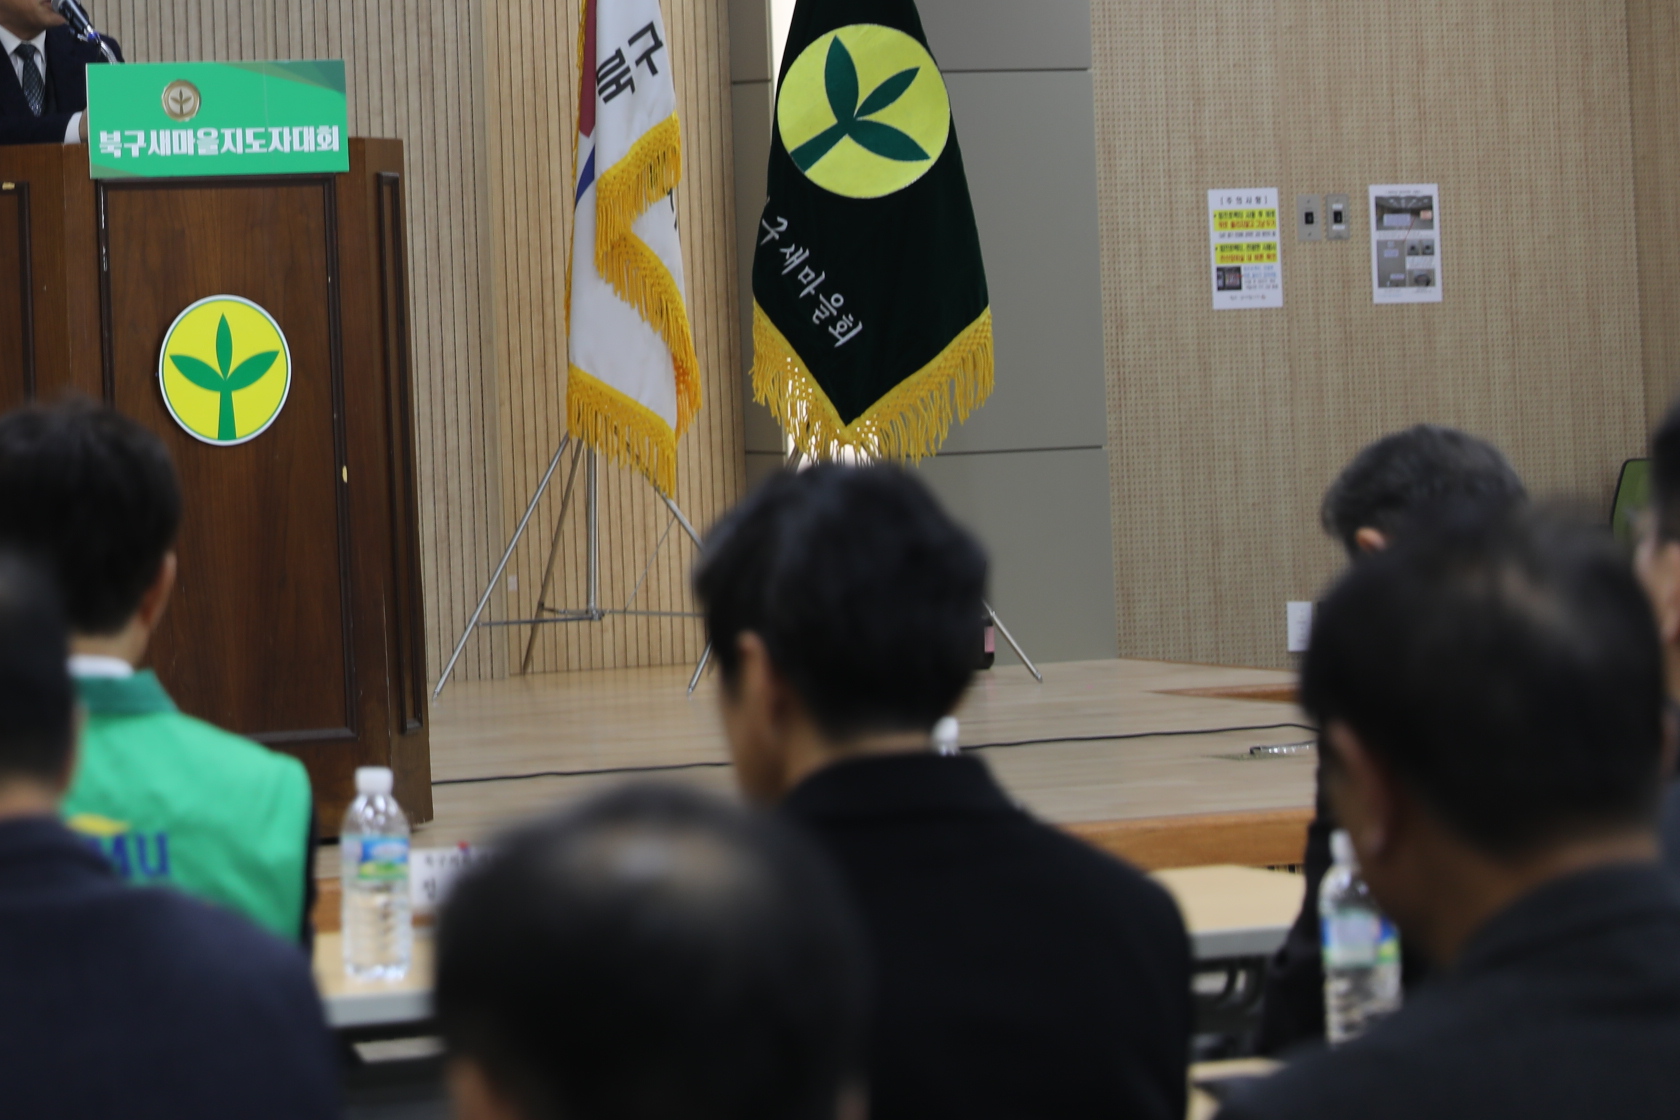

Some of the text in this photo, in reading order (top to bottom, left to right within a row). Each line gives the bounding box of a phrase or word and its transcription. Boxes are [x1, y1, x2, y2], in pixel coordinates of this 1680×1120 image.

[596, 20, 664, 105] 북구
[99, 125, 340, 158] 북구새마을지도자대회
[760, 214, 863, 348] 구새마을회
